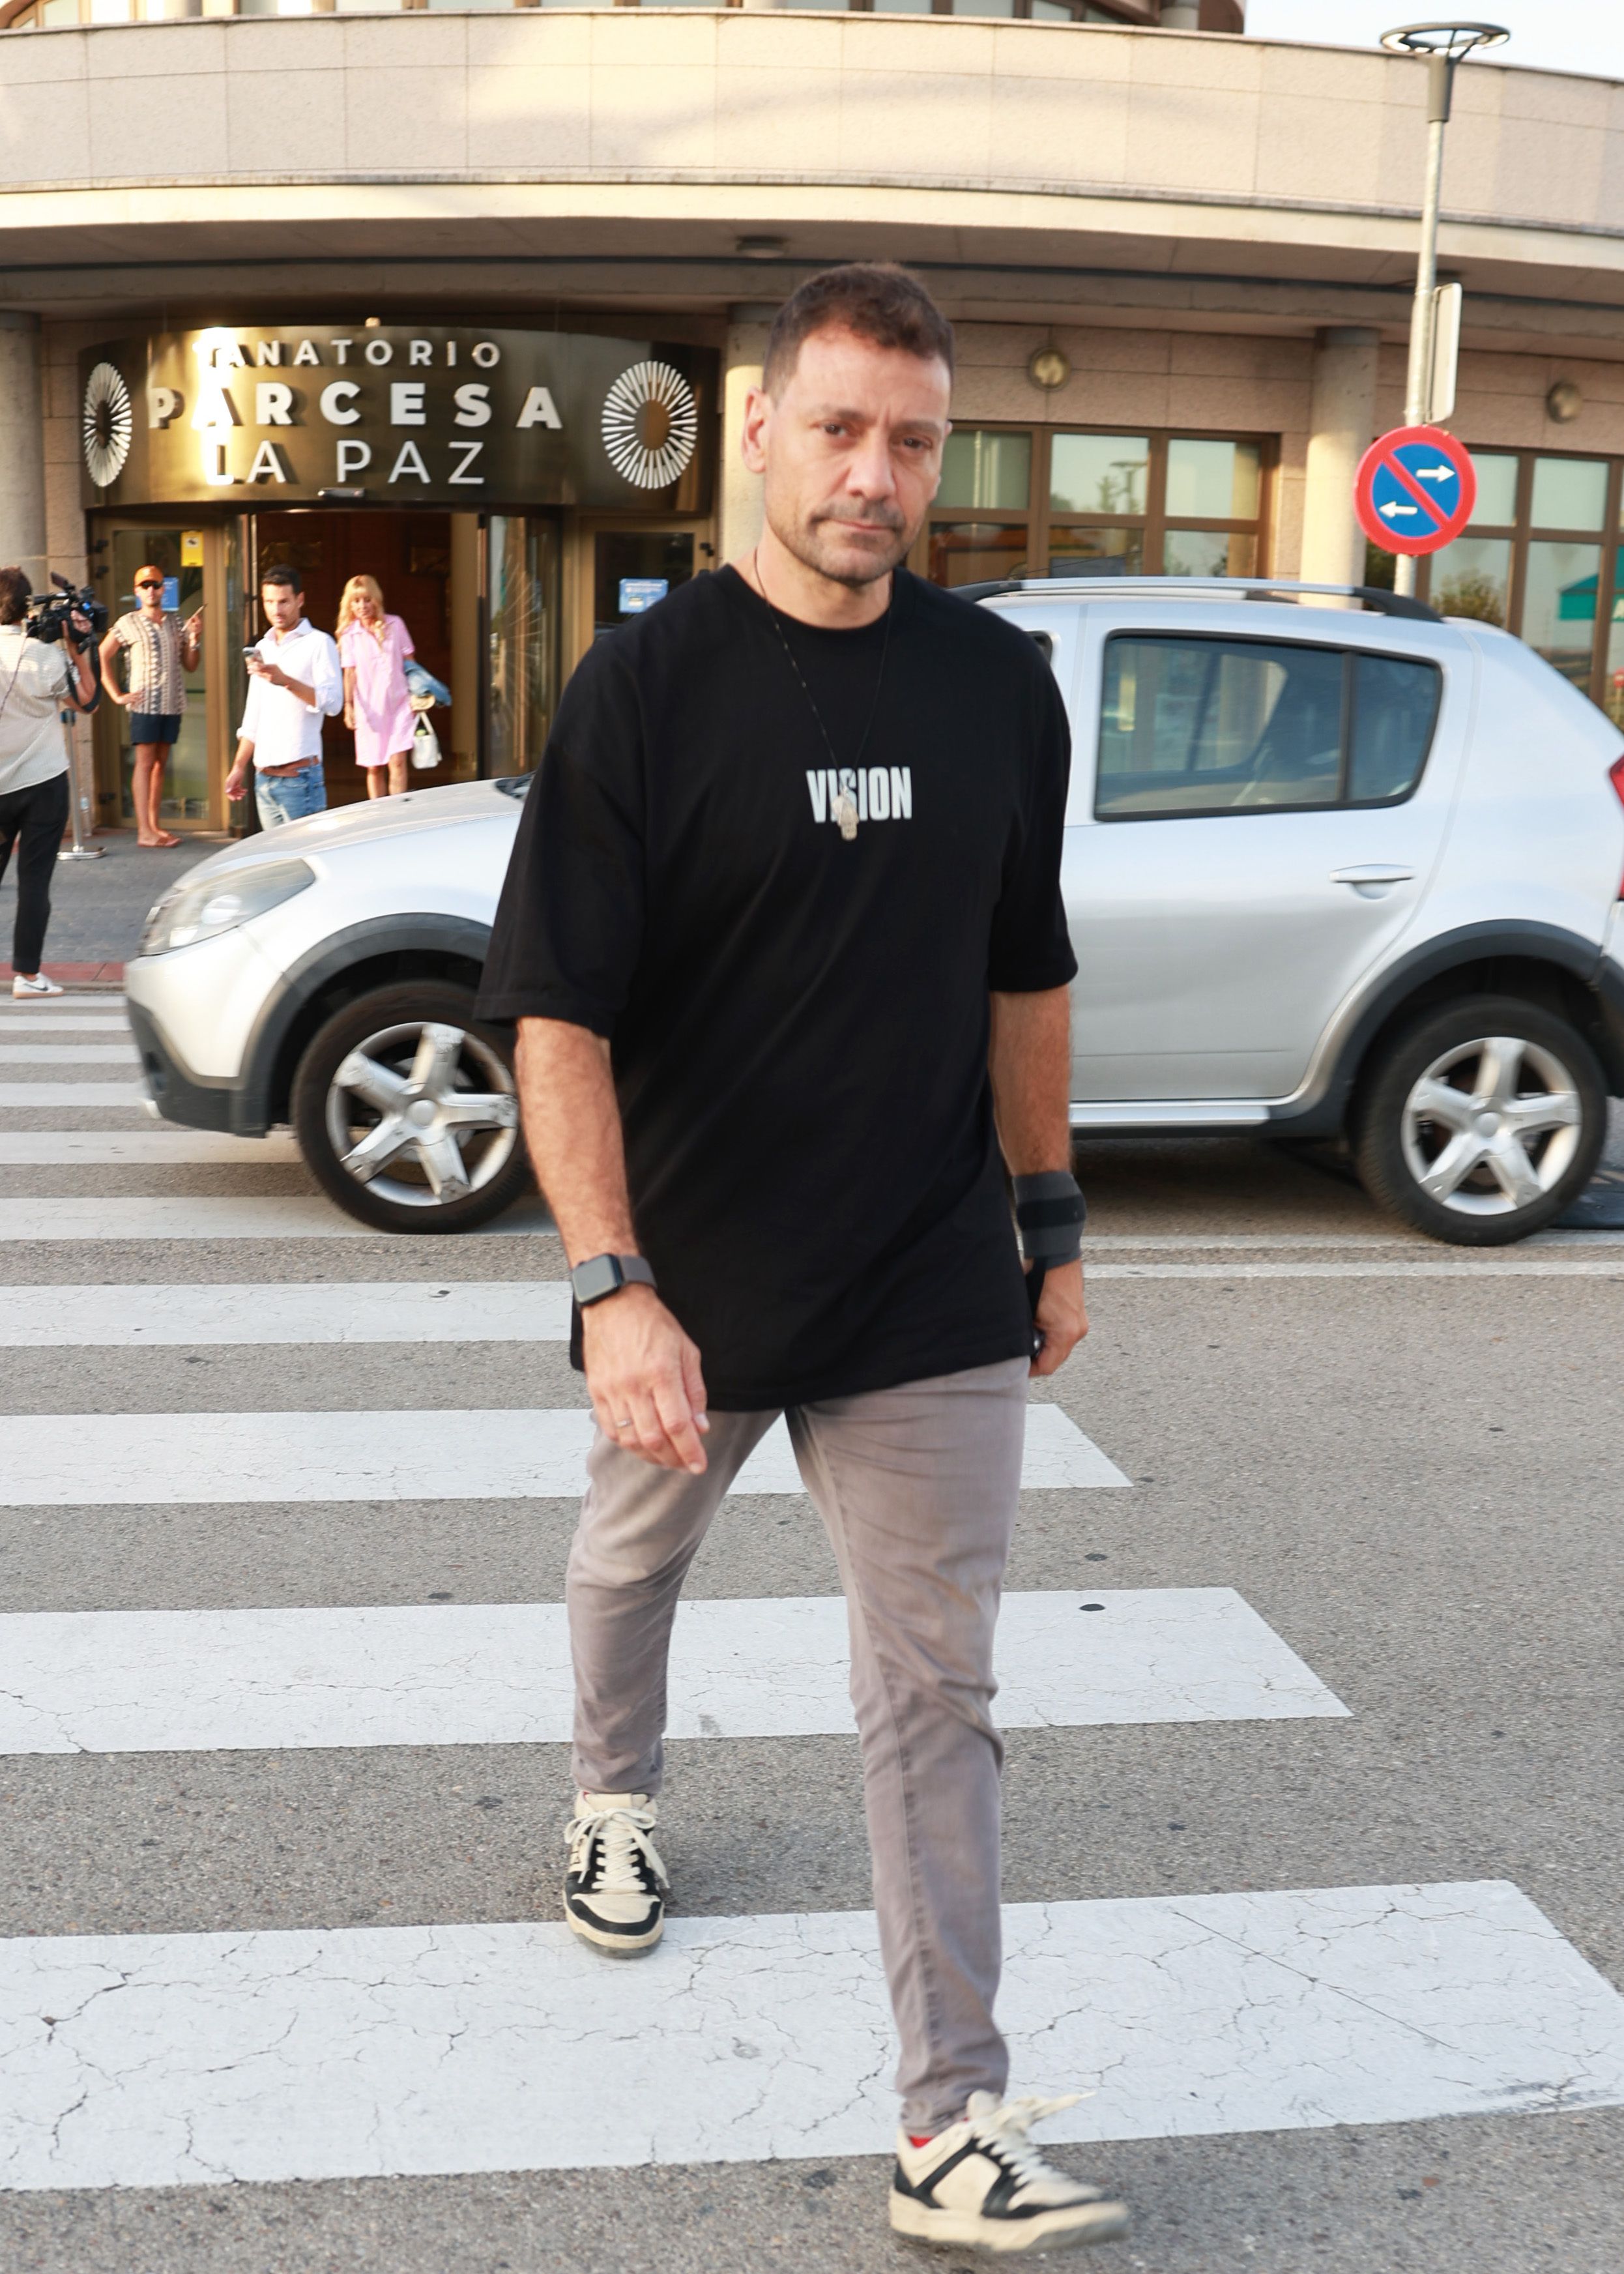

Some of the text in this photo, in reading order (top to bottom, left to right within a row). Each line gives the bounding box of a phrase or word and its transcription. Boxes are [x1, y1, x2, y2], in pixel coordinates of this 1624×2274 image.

[192, 339, 500, 368] TANATORIO
[148, 381, 563, 430] PARCESA
[207, 439, 485, 485] LA PAZ
[805, 766, 912, 823] VISION
